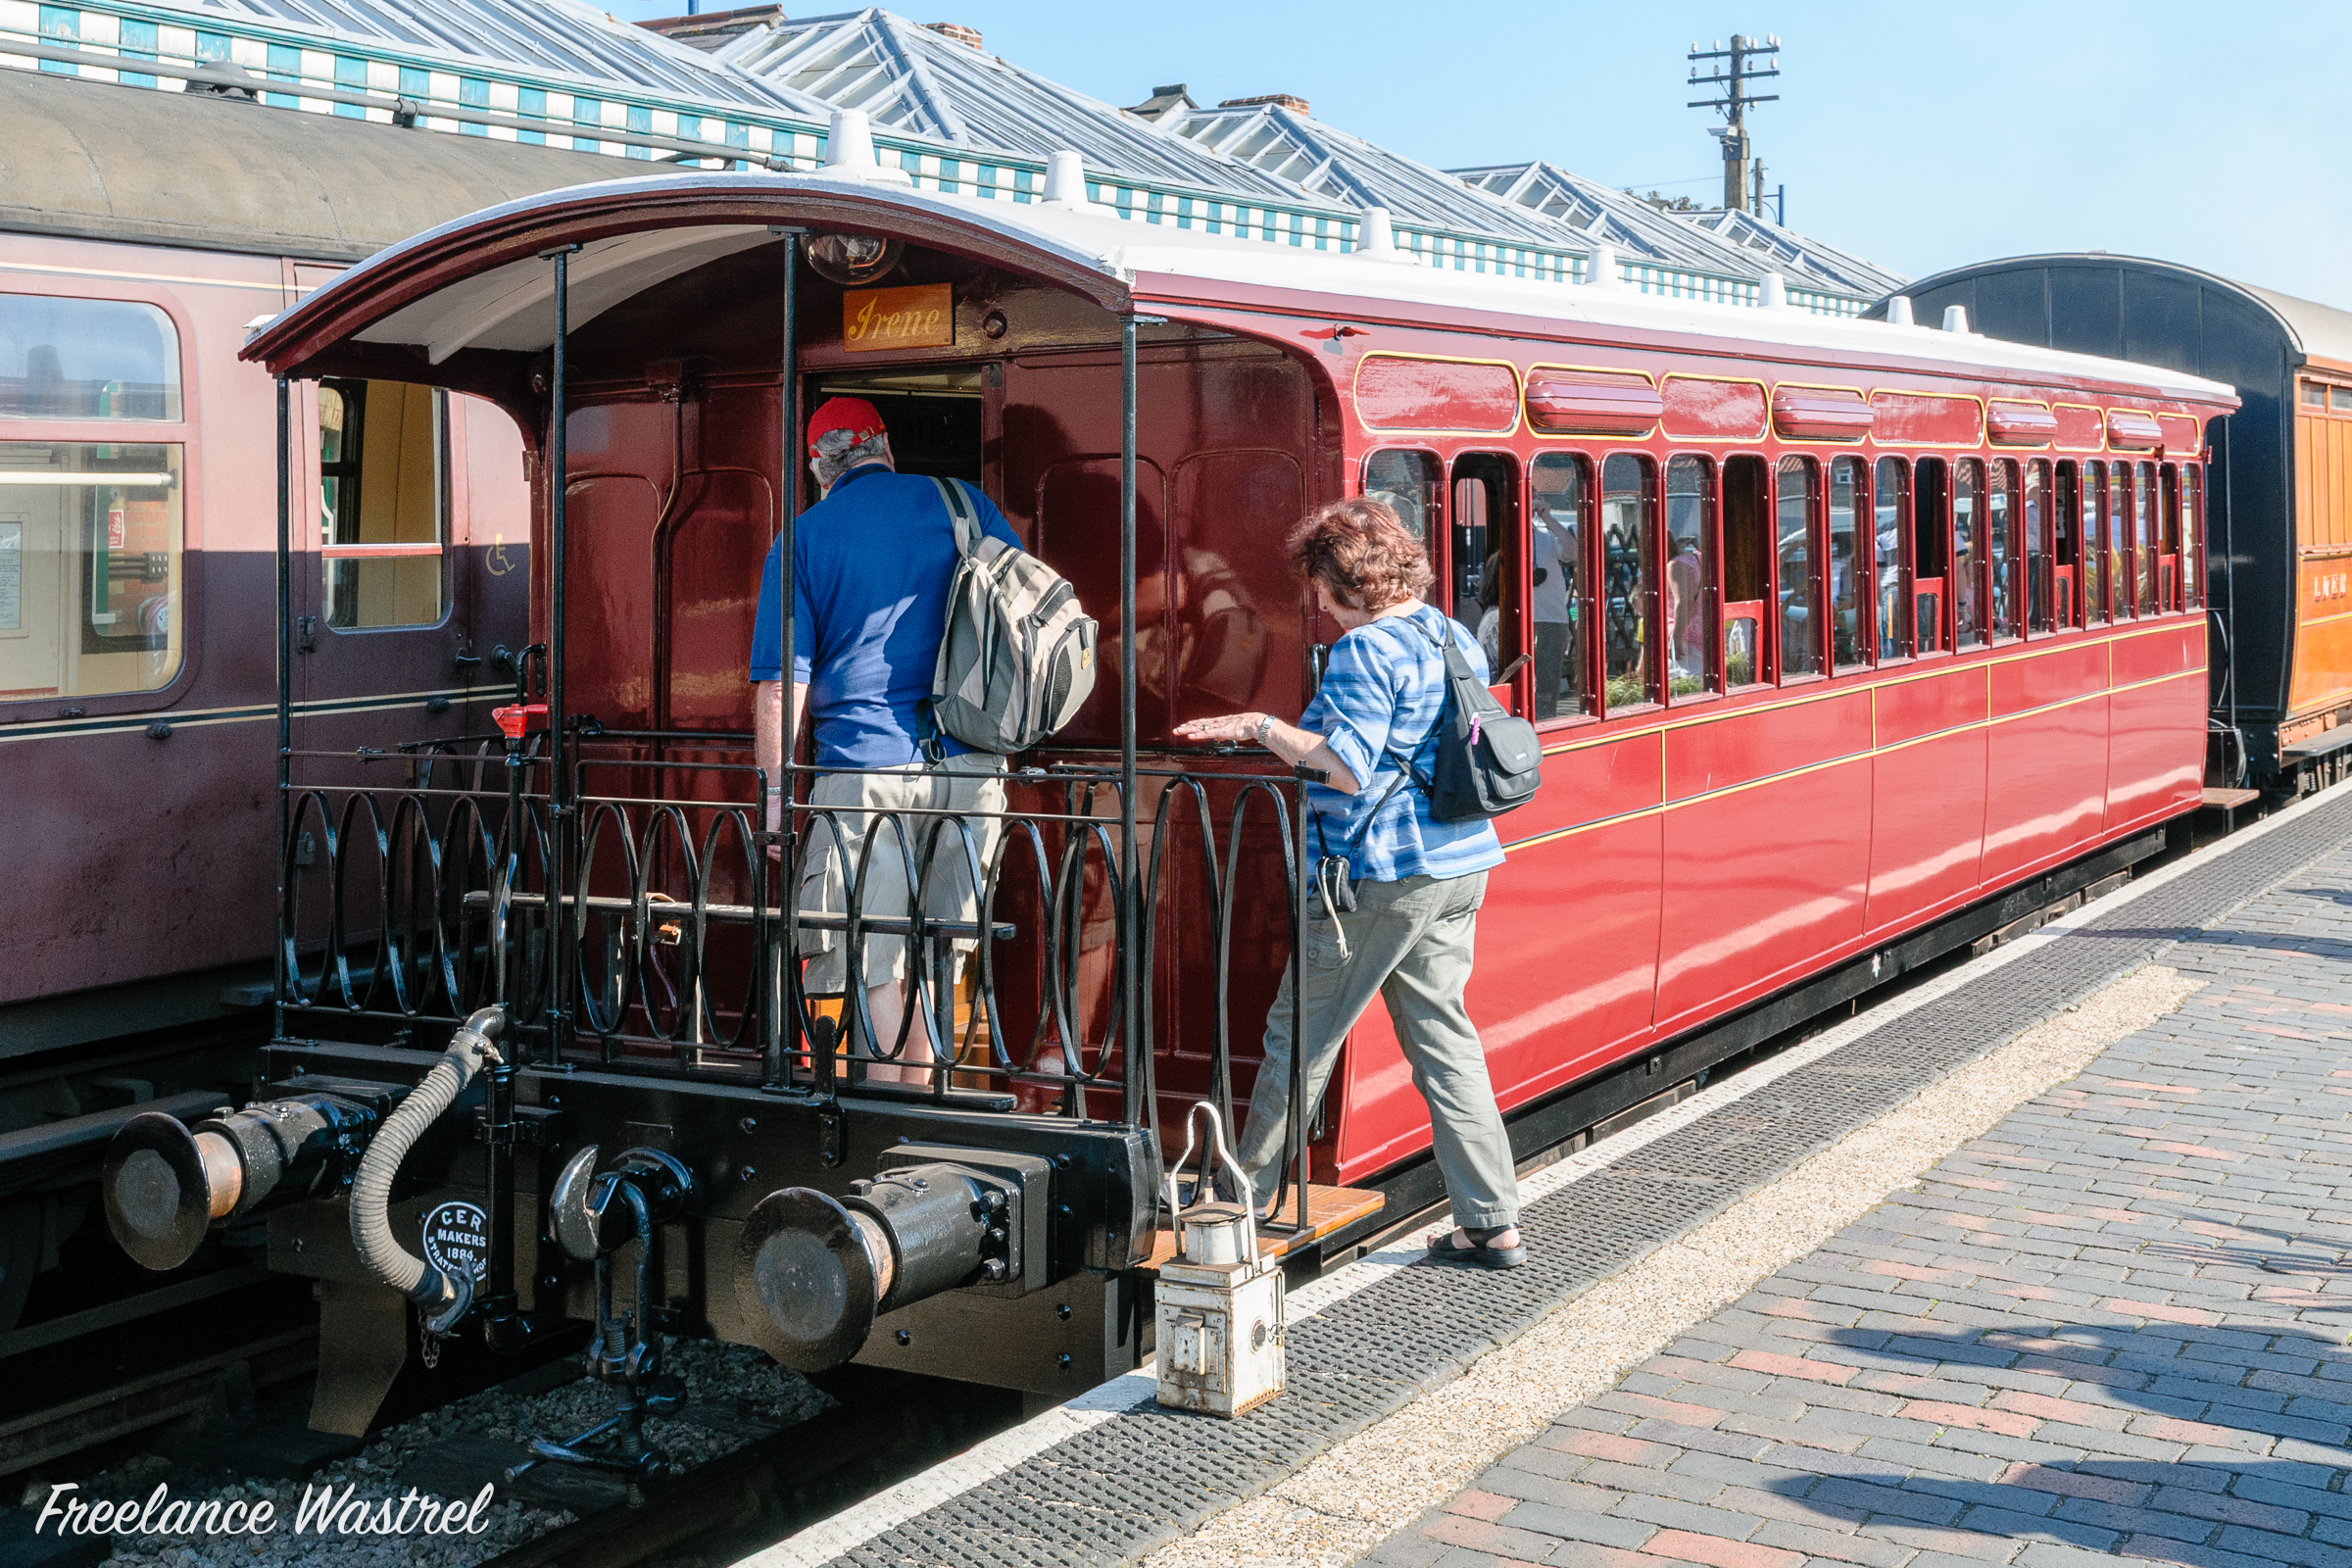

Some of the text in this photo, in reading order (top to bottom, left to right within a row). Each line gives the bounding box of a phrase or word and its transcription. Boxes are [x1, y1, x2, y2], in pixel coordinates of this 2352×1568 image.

[848, 295, 941, 341] Irene
[2314, 573, 2347, 601] LNER
[437, 1228, 486, 1248] MAKERS
